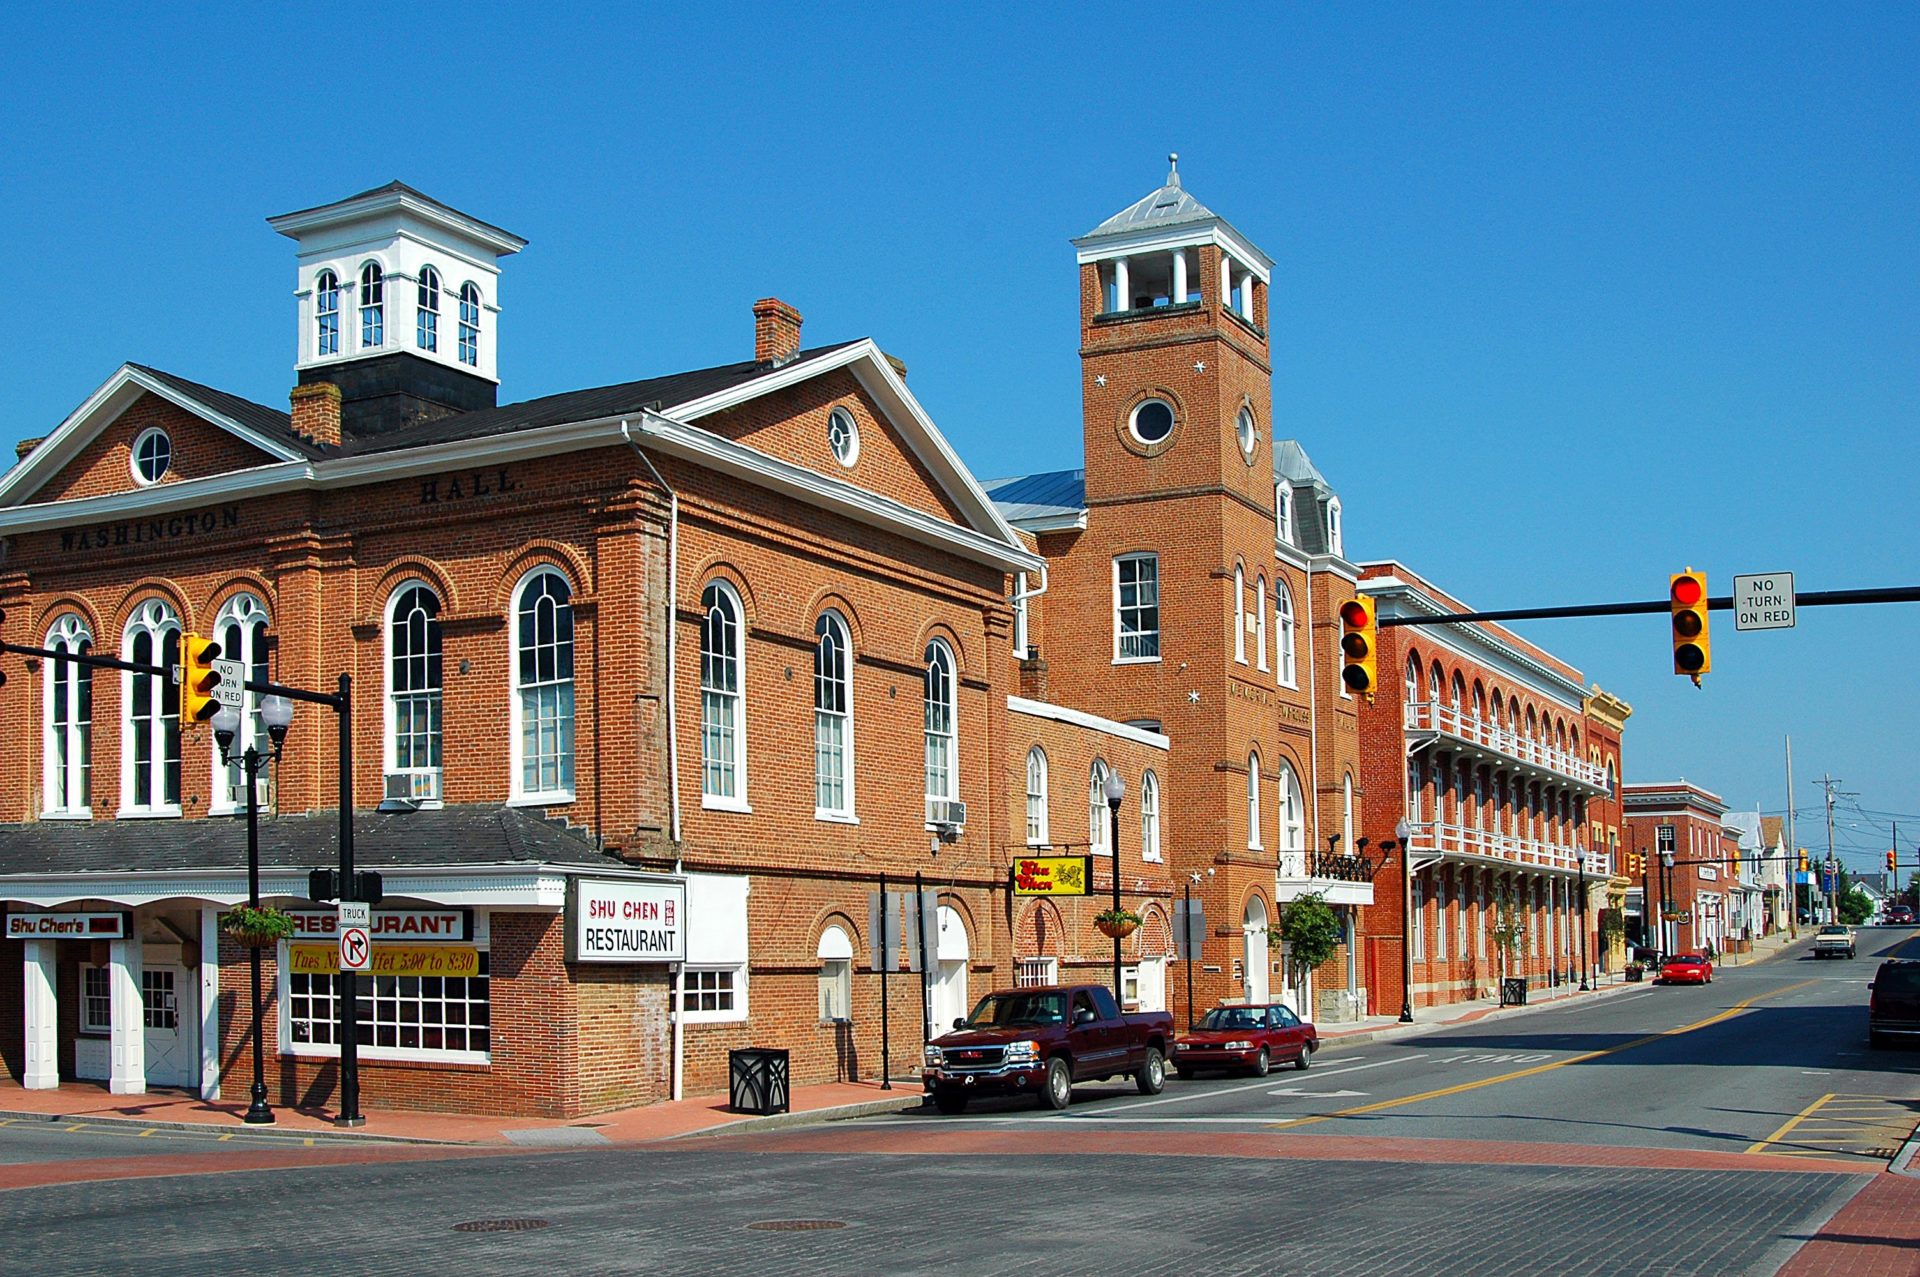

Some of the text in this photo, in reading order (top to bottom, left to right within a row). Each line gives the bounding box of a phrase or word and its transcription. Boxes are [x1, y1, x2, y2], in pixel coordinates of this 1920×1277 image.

[60, 506, 240, 550] WASHINGTON
[1753, 580, 1774, 592] NO
[1747, 595, 1782, 607] TURN
[1740, 610, 1790, 623] ON RED
[220, 665, 233, 675] NO
[220, 679, 237, 688] URN
[210, 690, 241, 702] ON RED
[343, 908, 366, 919] TRUCK
[590, 900, 616, 919] SHU
[623, 901, 659, 920] CHEN
[10, 918, 36, 933] Shu
[39, 917, 84, 933] Chen's
[291, 915, 457, 933] RESURANT
[586, 928, 676, 952] RESTAURANT
[294, 950, 320, 969] Tues
[371, 952, 394, 970] ffet
[430, 953, 443, 970] to
[448, 952, 474, 971] 8:30
